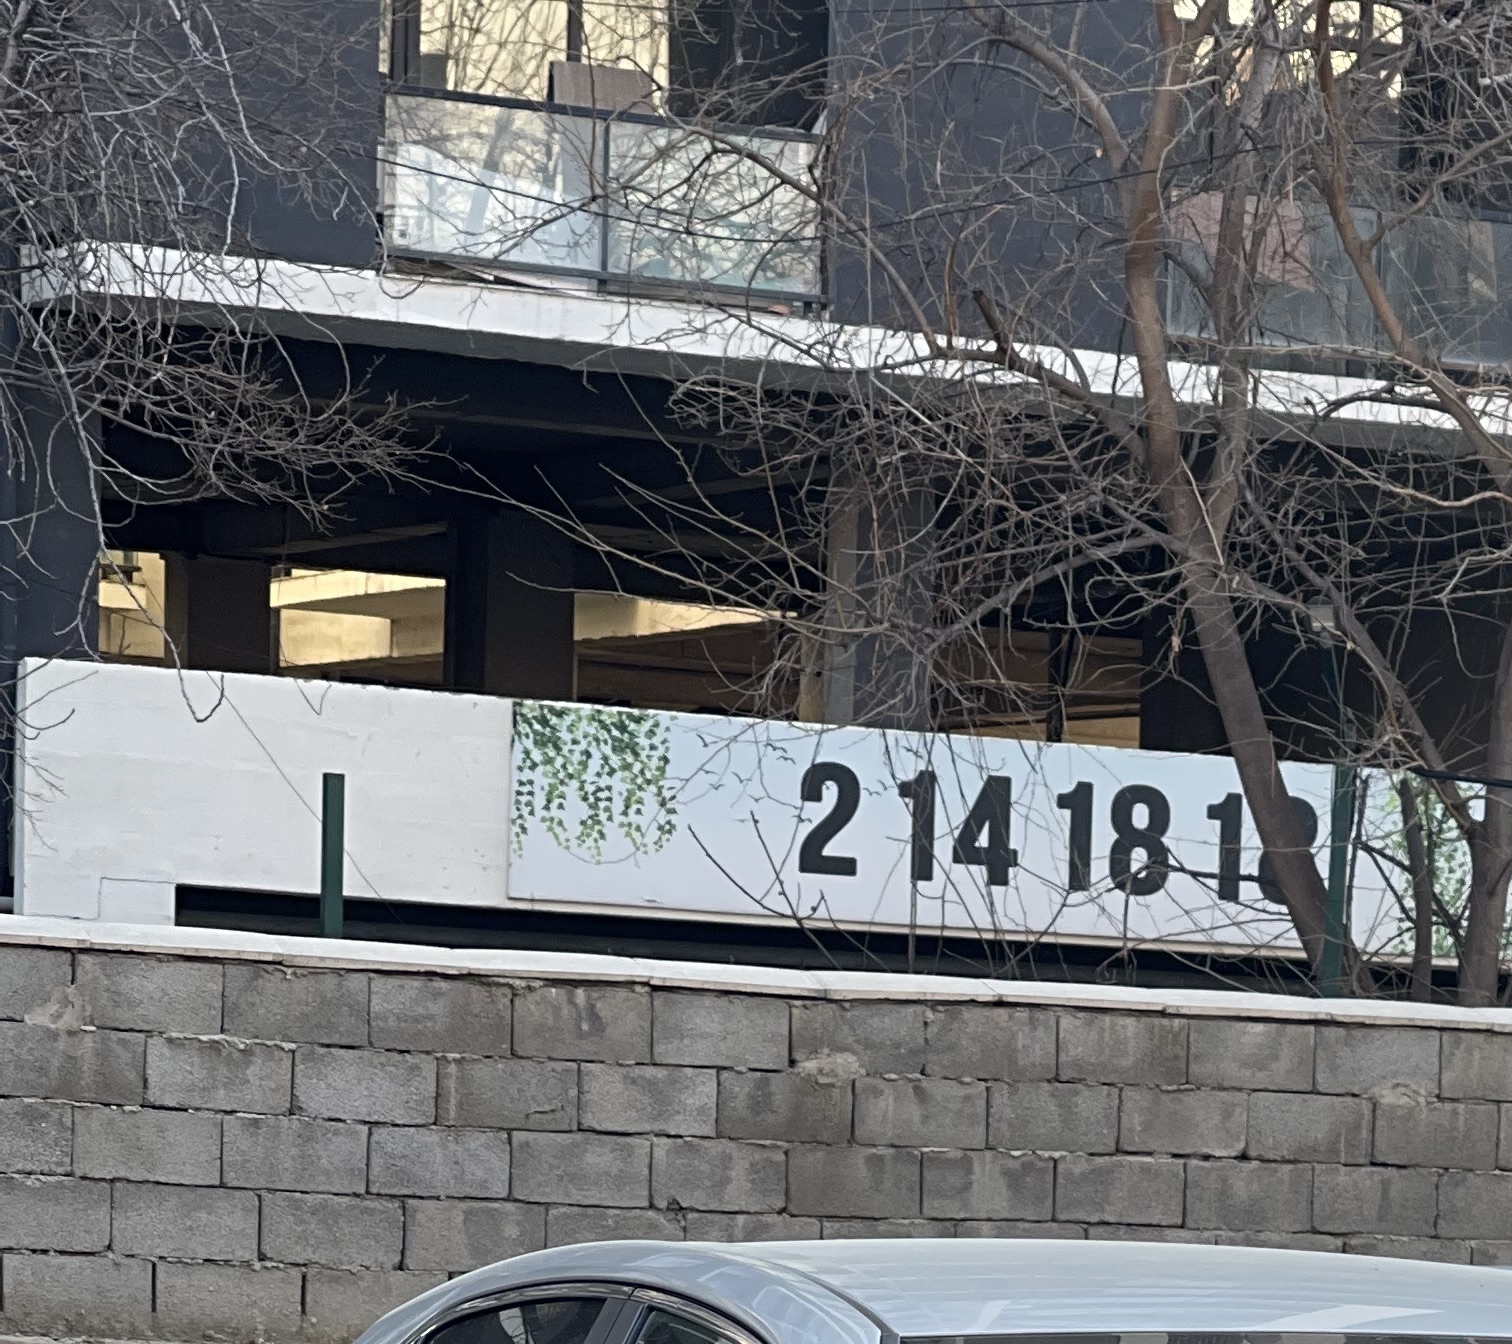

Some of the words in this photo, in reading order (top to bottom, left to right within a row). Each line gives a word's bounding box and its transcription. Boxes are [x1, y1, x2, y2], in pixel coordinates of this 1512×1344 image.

[799, 761, 861, 877] 2
[898, 769, 1019, 887] 14
[1056, 780, 1171, 897] 18
